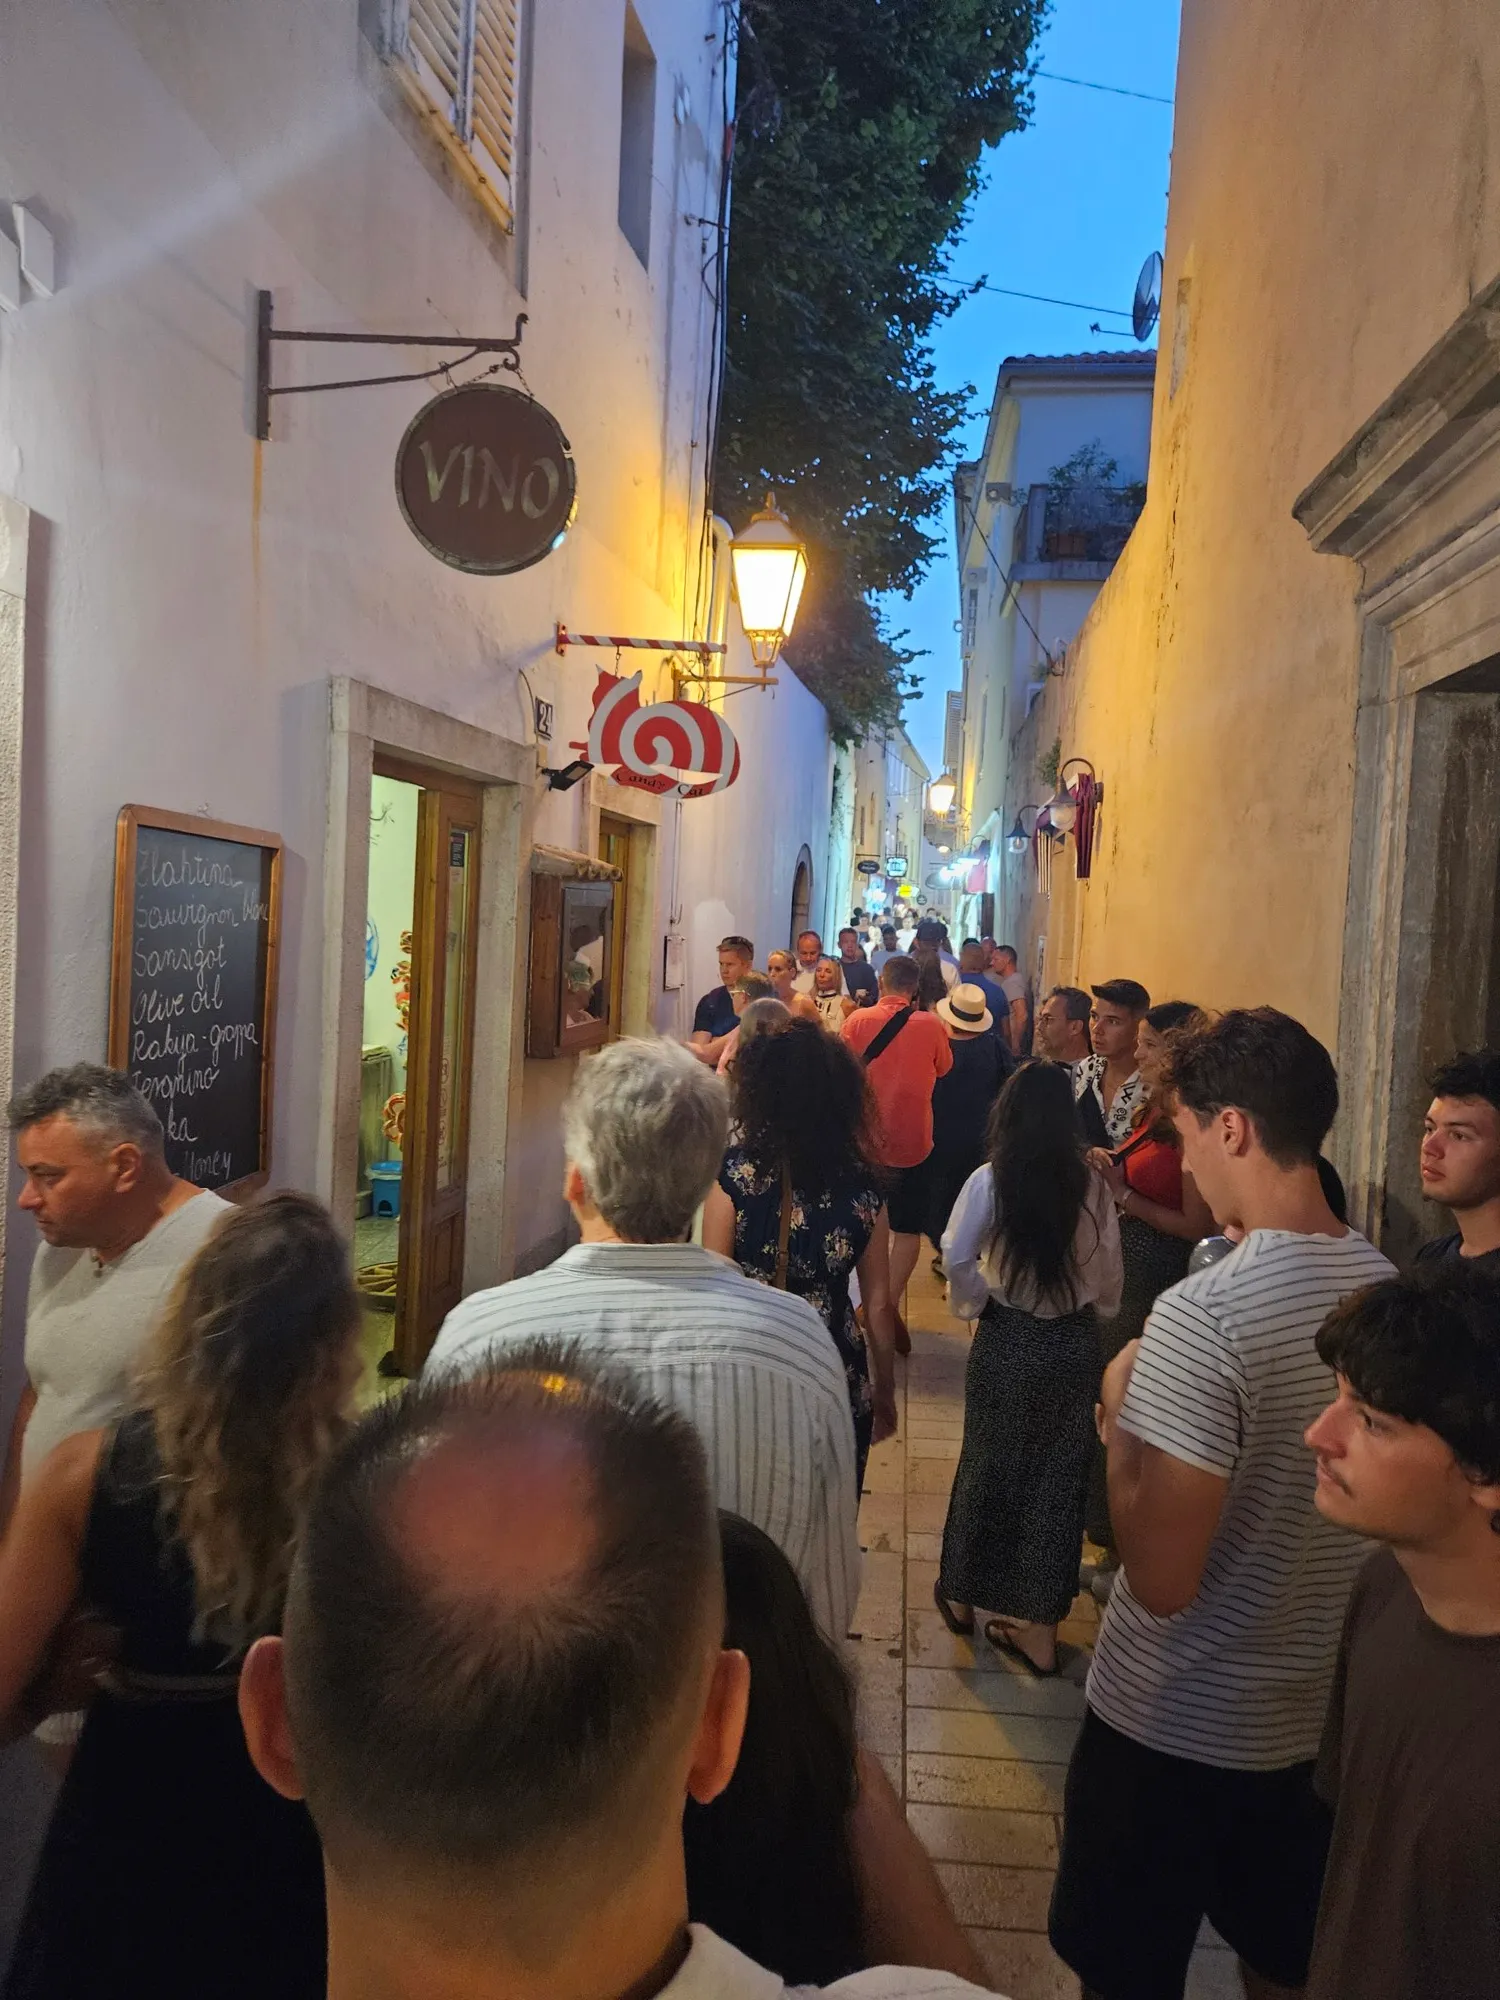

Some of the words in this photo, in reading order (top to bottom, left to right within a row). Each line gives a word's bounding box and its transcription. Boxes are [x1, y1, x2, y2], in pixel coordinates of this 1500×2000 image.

[419, 441, 559, 519] VINO
[538, 703, 553, 734] 24
[616, 774, 665, 789] Candy
[677, 783, 704, 796] Cat
[136, 894, 239, 948] Sauvignon
[134, 936, 227, 990] Sansigot
[133, 989, 185, 1025] Olive
[191, 974, 223, 1013] oil
[184, 1150, 231, 1181] Honey
